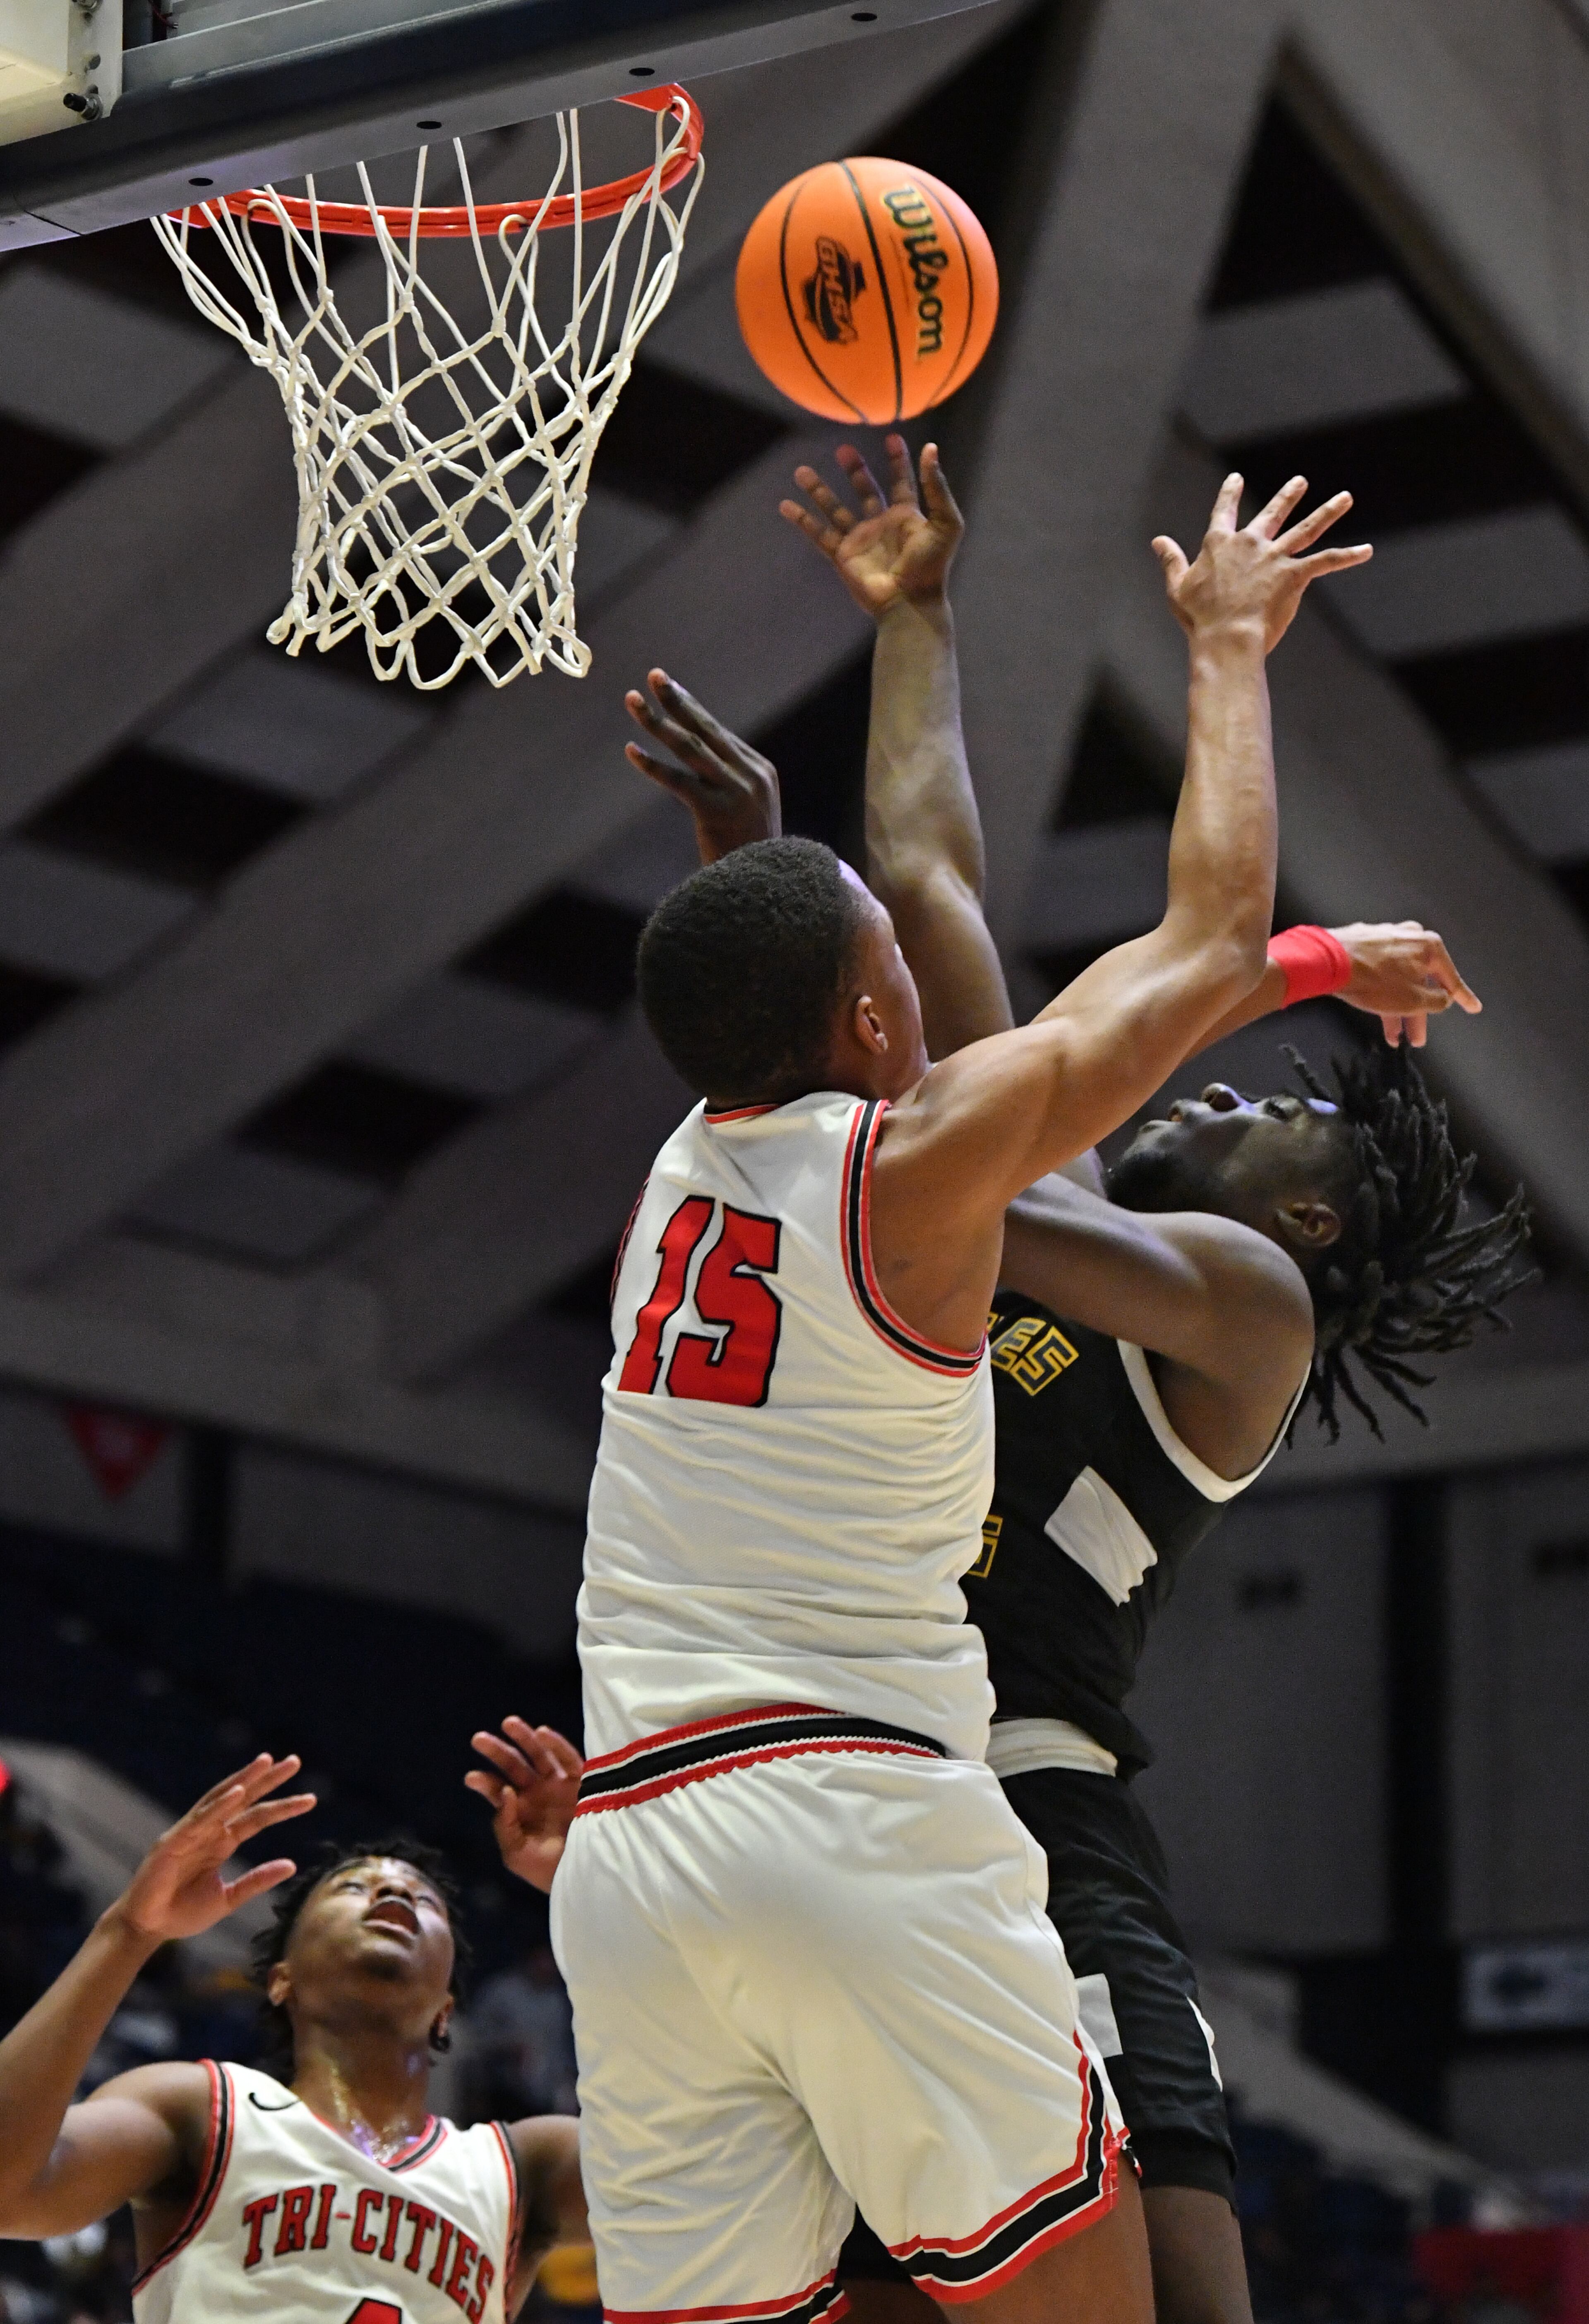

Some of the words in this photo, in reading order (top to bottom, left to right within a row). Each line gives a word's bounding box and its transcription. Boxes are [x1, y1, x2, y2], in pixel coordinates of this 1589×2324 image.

[882, 186, 948, 358] Wilson
[617, 1194, 782, 1408] 15
[987, 1311, 1079, 1396] ES
[242, 2184, 494, 2324] TRI-CITIES
